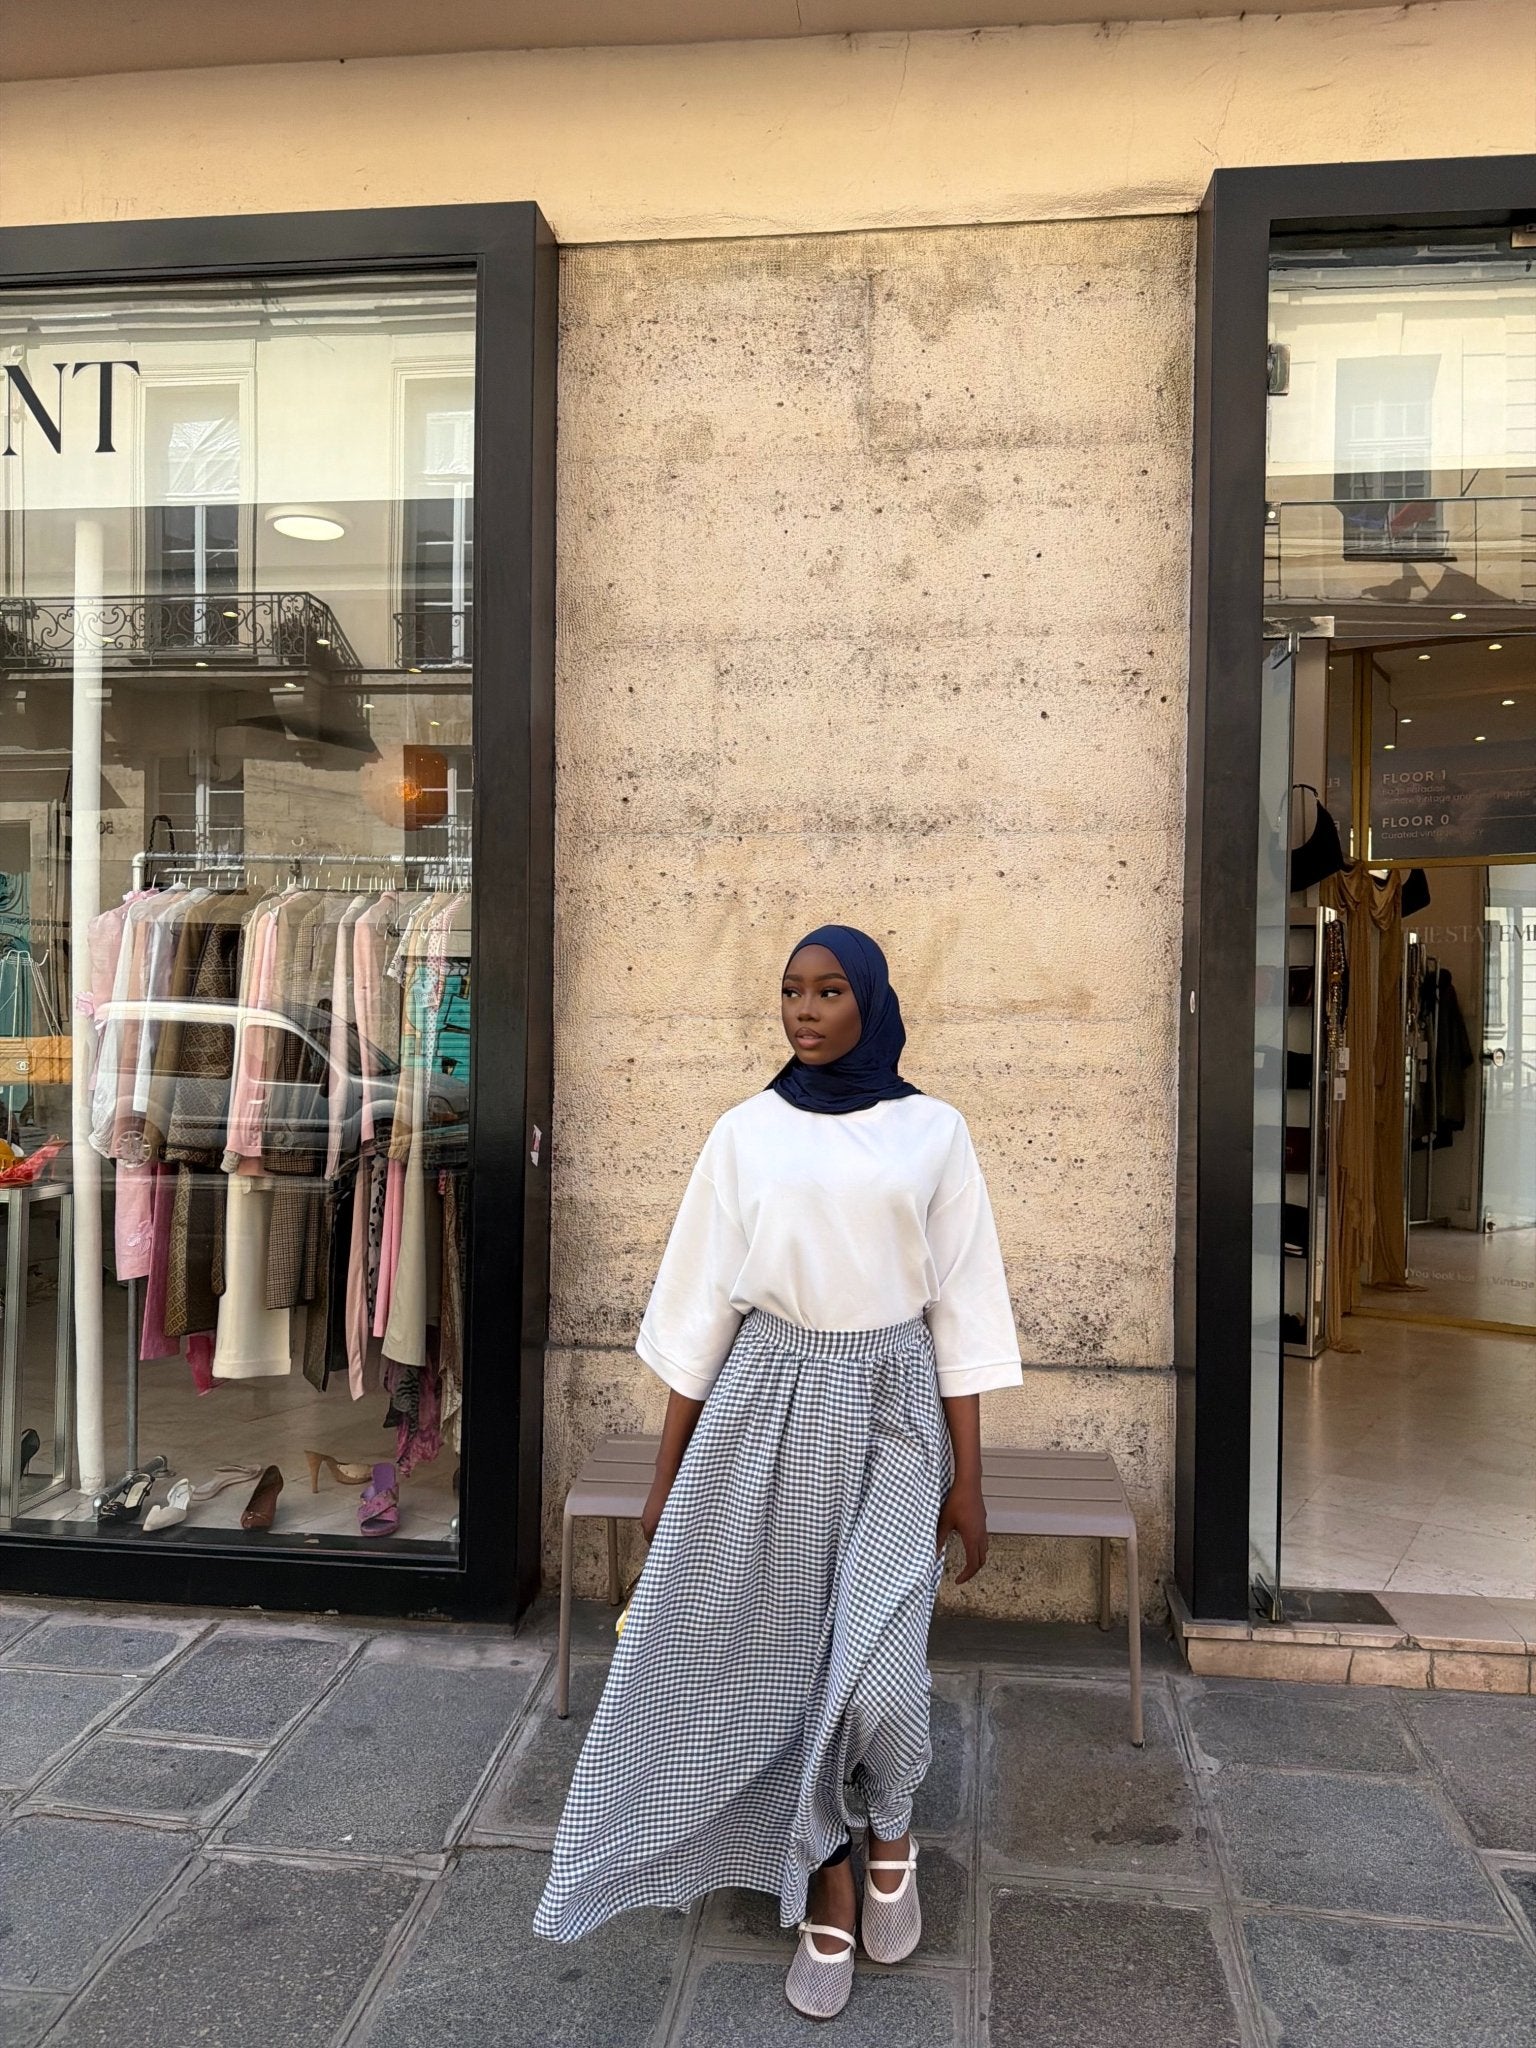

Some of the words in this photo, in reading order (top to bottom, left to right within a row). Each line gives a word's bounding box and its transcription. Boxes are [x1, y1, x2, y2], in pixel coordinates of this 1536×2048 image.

[2, 360, 140, 456] NT
[1383, 771, 1434, 784] FLOOR
[1441, 769, 1446, 780] 1
[1382, 815, 1434, 828] FLOOR
[1440, 814, 1450, 825] 0
[1381, 830, 1418, 840] Curated
[1446, 924, 1536, 943] STATEM
[1409, 1268, 1429, 1279] You
[1432, 1270, 1455, 1280] look
